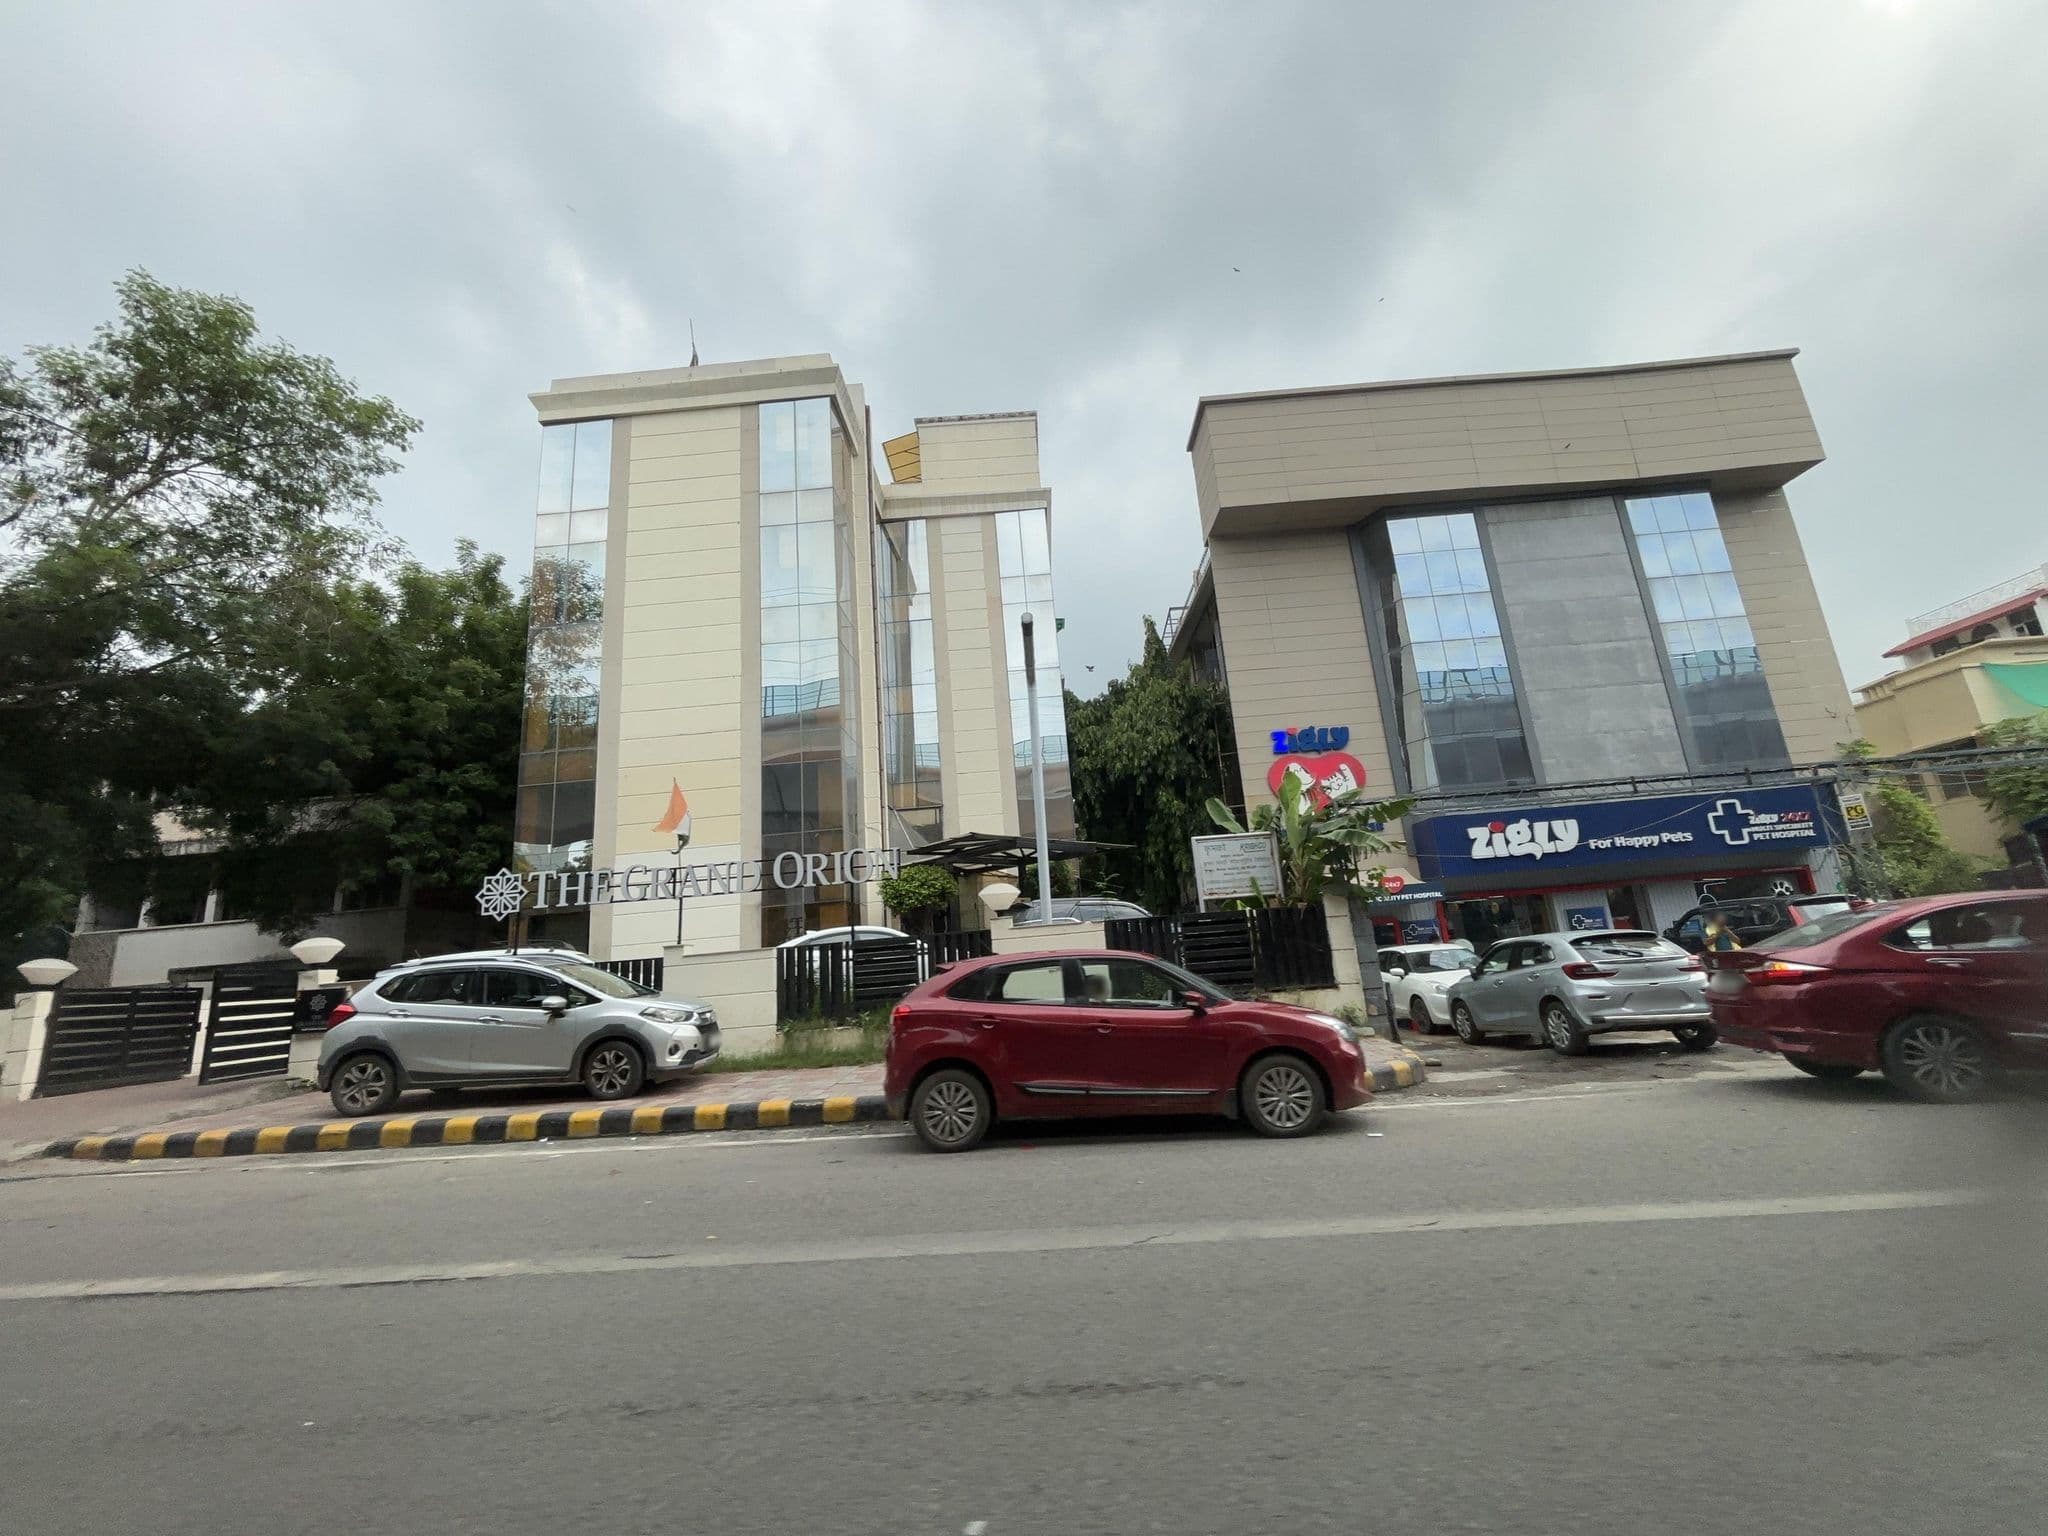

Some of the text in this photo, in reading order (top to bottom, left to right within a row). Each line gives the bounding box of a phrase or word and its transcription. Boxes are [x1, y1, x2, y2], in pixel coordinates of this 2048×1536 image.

[1588, 831, 1694, 850] For Happy Pets
[1752, 829, 1816, 841] PET HOSPITAL
[528, 847, 900, 909] THE GRAND ORION
[1413, 891, 1443, 899] HOSPITAL
